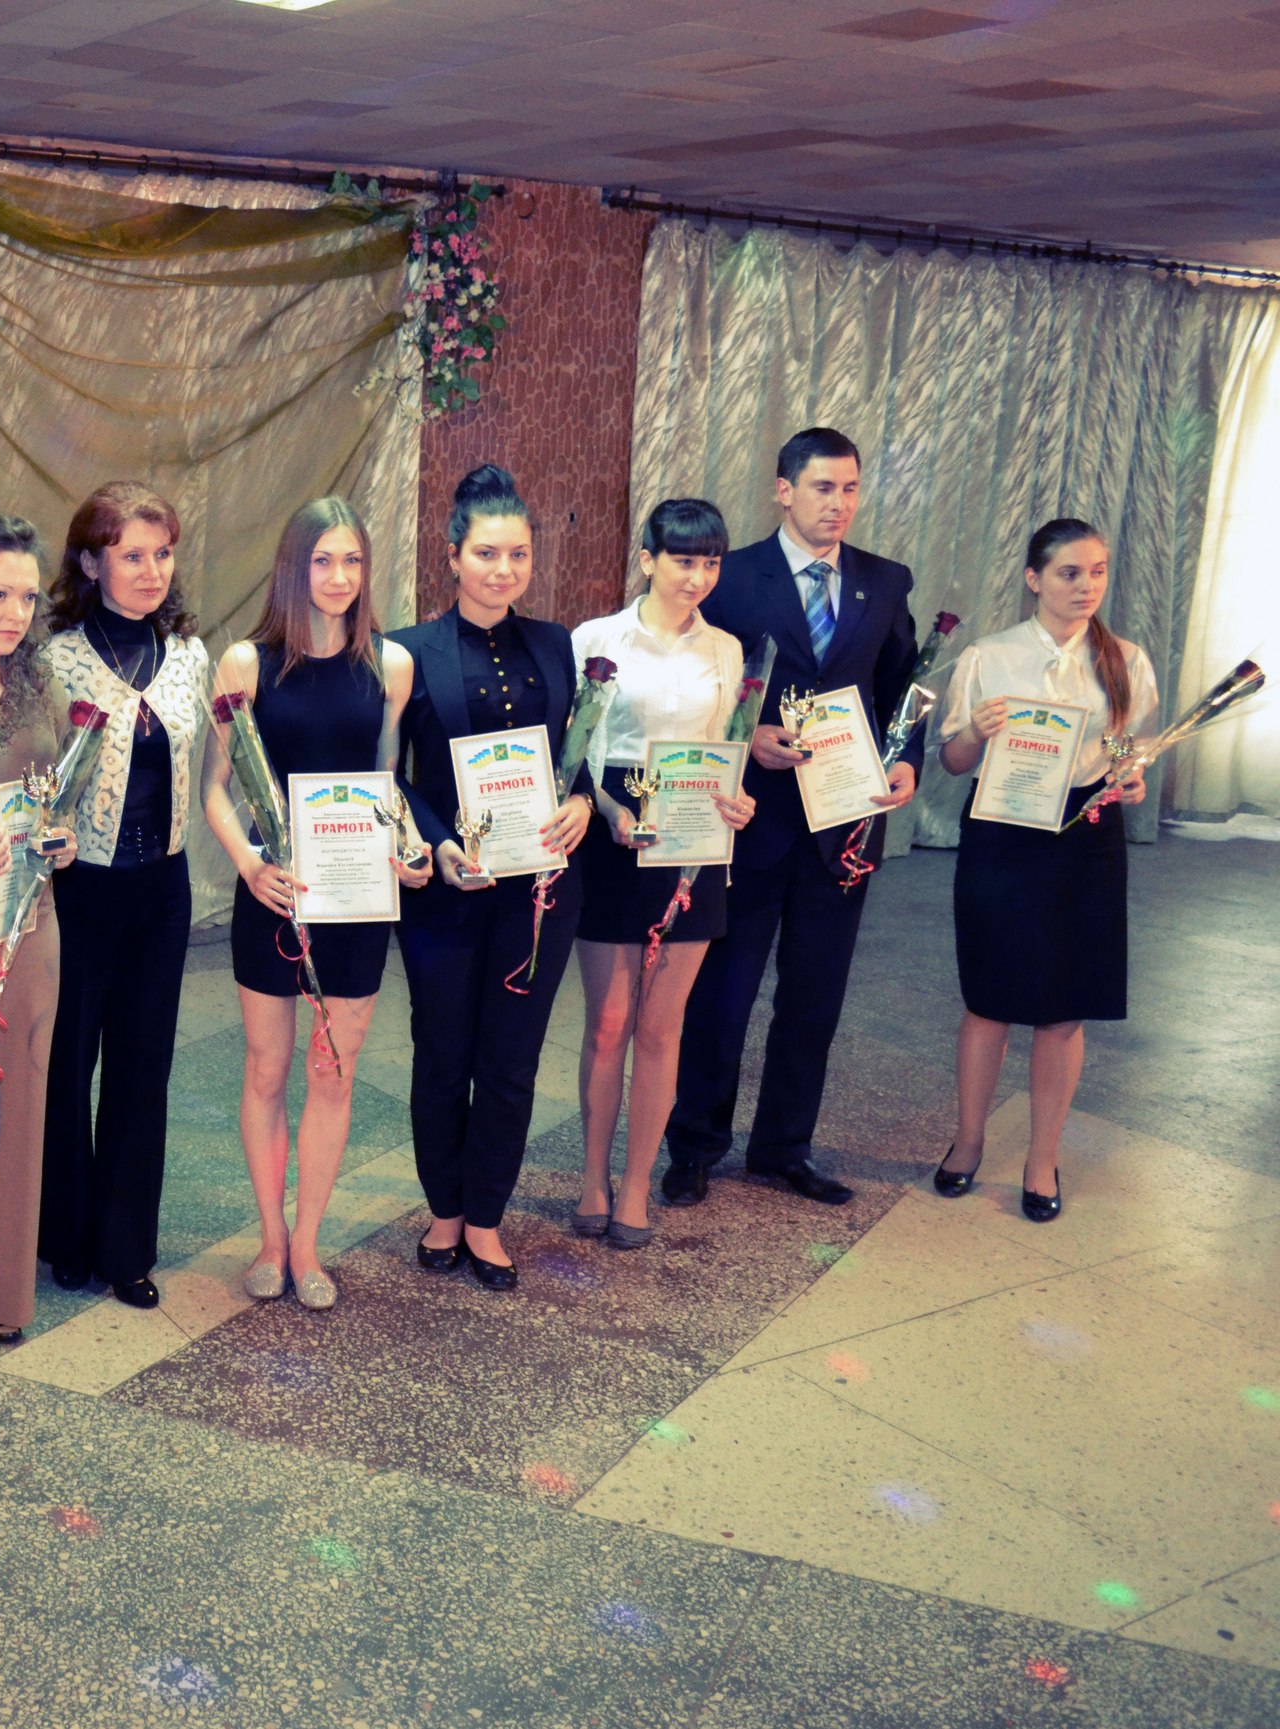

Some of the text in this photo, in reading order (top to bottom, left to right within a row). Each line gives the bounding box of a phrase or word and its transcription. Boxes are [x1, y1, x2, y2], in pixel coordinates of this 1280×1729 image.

[1008, 738, 1059, 754] ГРАМОТА
[479, 776, 534, 794] ГРАМОТА
[664, 780, 719, 790] ГРАМОТА
[313, 822, 373, 834] ГРАМОТА
